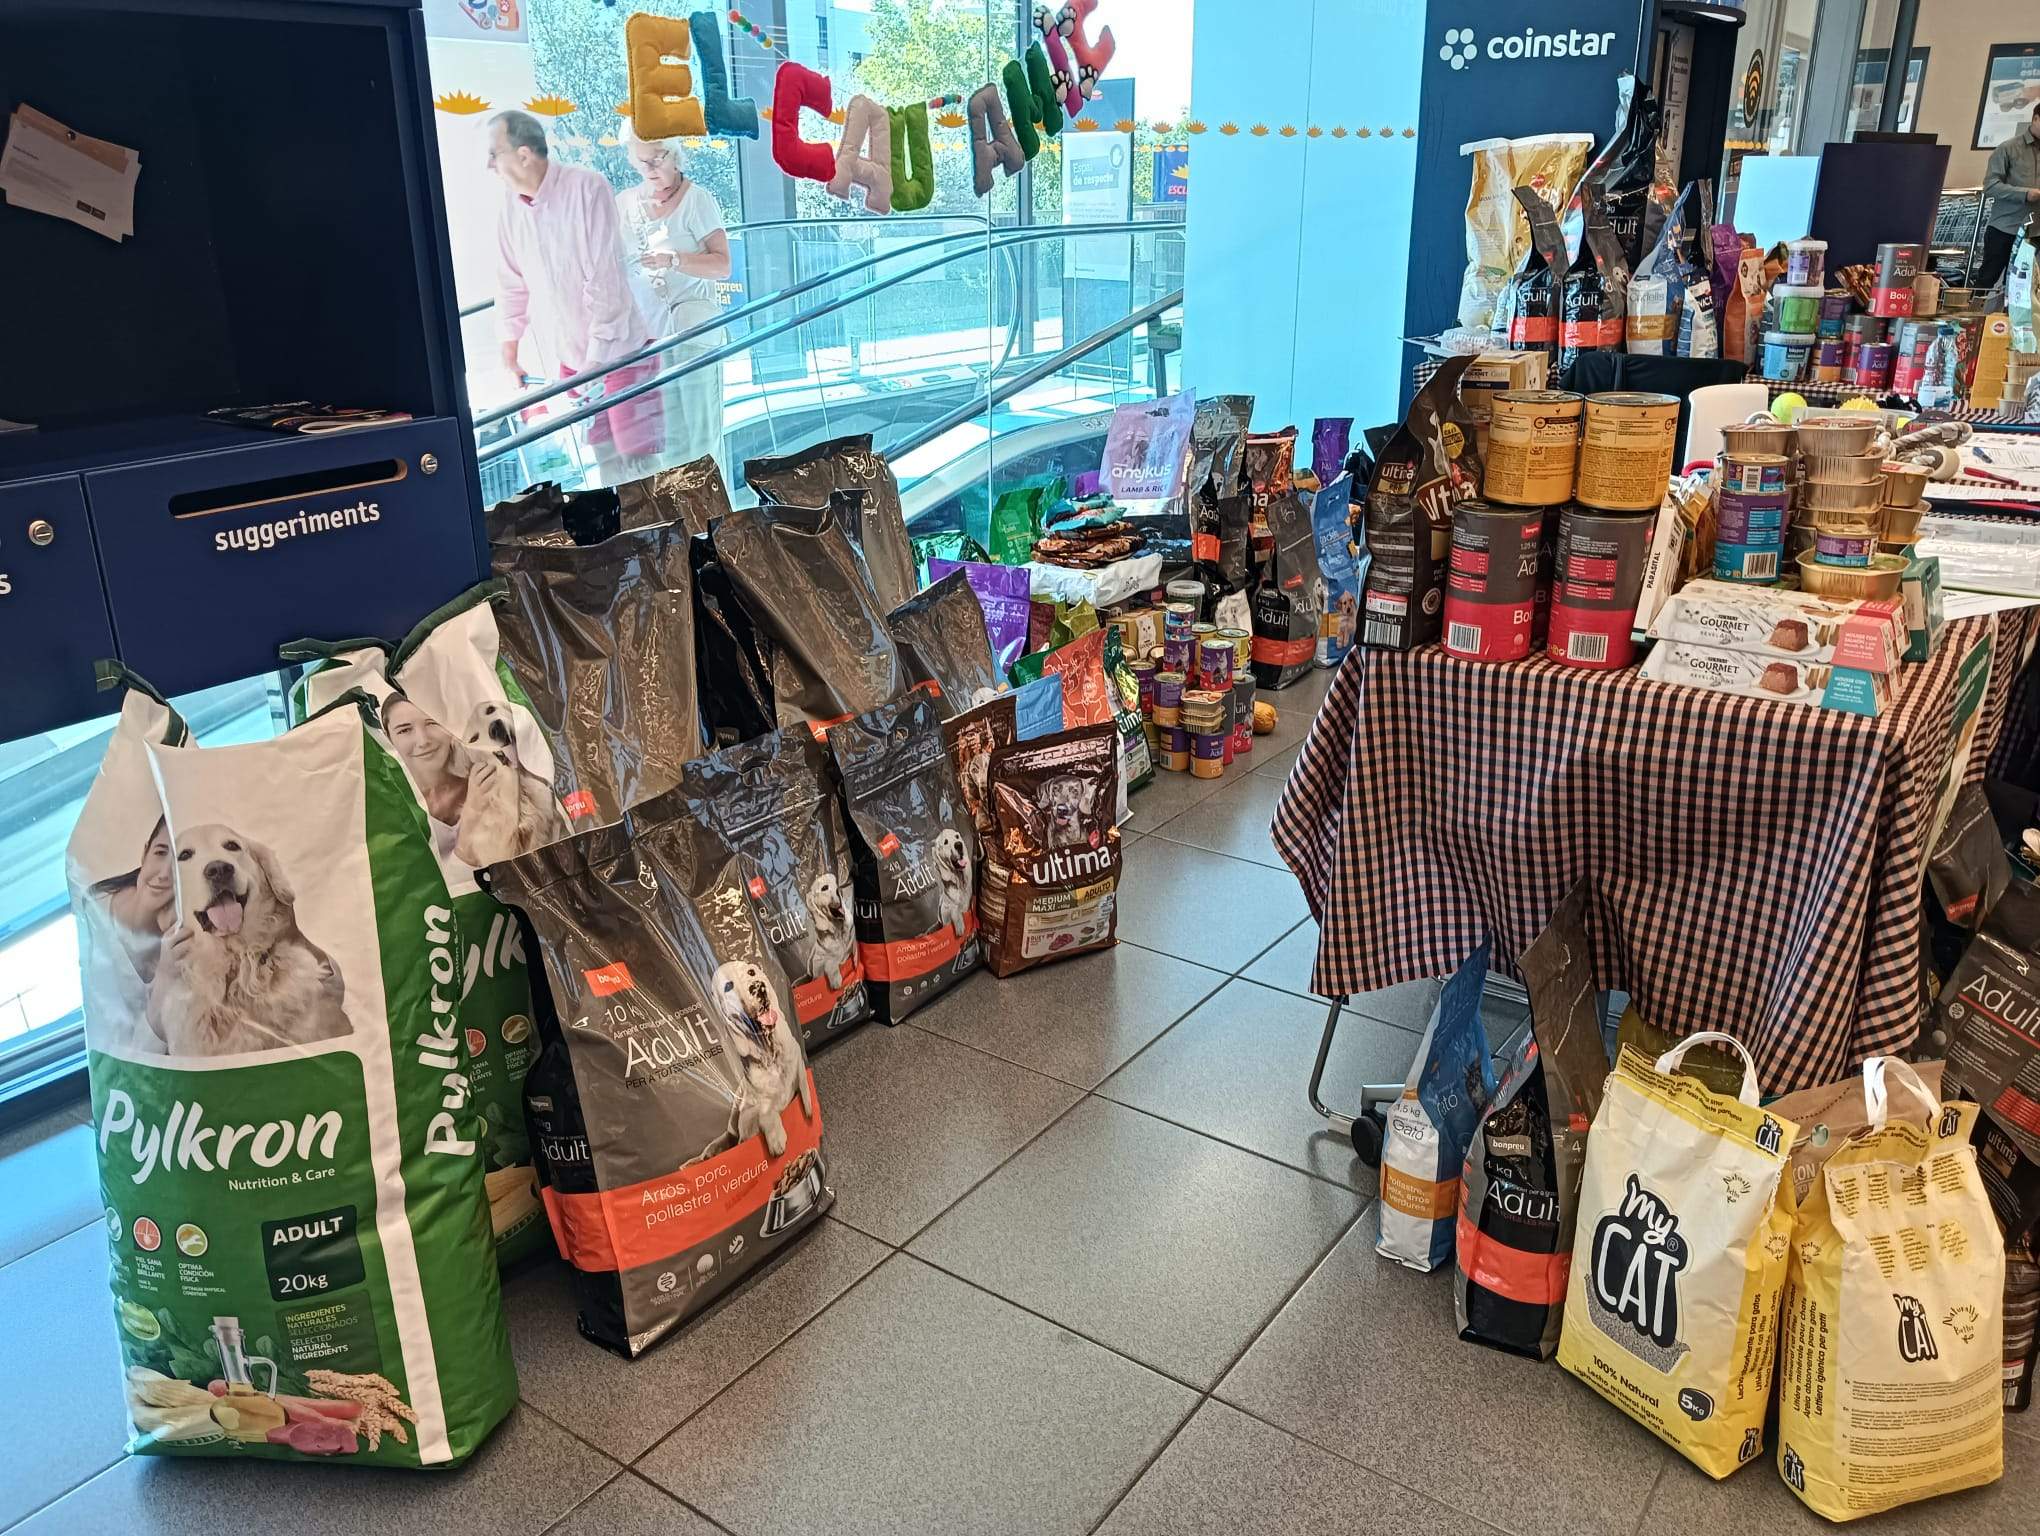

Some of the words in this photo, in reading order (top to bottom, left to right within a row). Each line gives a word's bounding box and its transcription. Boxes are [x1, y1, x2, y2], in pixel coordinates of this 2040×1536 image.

[1487, 27, 1616, 59] coinstar
[626, 12, 759, 141] EL
[772, 60, 934, 215] CAU
[1611, 220, 1637, 235] dult
[1566, 293, 1599, 306] Adult
[1111, 463, 1172, 483] amykus
[215, 501, 380, 551] suggeriments
[1646, 551, 1661, 588] PARASITAL
[1258, 608, 1289, 627] Adult
[1700, 615, 1750, 631] GOURMET
[1690, 658, 1739, 674] GOURMET
[1032, 845, 1112, 885] ultima
[894, 863, 936, 900] Adult
[1084, 881, 1111, 898] ADULTO
[1032, 904, 1056, 912] MAXI
[1033, 893, 1071, 905] MEDIUM
[770, 911, 806, 945] dult
[604, 1005, 627, 1025] 10
[416, 904, 476, 1156] Pylkron
[624, 1012, 719, 1079] Adult
[625, 1078, 647, 1090] PER
[648, 1075, 656, 1083] A
[1410, 1105, 1421, 1118] kg
[100, 1089, 343, 1185] Pylkron
[1940, 1114, 1959, 1137] CAT
[541, 1137, 590, 1162] Adult
[1492, 1139, 1525, 1151] bonpreu
[1757, 1127, 1781, 1154] CAT
[1987, 1131, 2018, 1166] ultima
[228, 1175, 288, 1192] Nutrition
[291, 1172, 302, 1184] &
[305, 1166, 336, 1182] Care
[1496, 1163, 1513, 1179] kg
[641, 1182, 691, 1207] Arròs,
[694, 1163, 732, 1190] porc,
[645, 1191, 712, 1229] pollastre
[715, 1184, 720, 1199] i
[722, 1158, 769, 1194] verdura
[1484, 1180, 1561, 1223] Adult
[1624, 1181, 1674, 1246] my
[272, 1215, 343, 1246] ADULT
[137, 1269, 166, 1280] BRILLANTE
[179, 1269, 214, 1278] CONDICIÓN
[278, 1273, 329, 1294] 20kg
[1597, 1222, 1680, 1337] CAT
[285, 1303, 346, 1323] INGREDIENTES
[1752, 1293, 1761, 1315] gatos
[1942, 1304, 1980, 1327] Naturally
[287, 1313, 337, 1330] NATURALES
[288, 1315, 359, 1337] SELECCIONADOS
[1820, 1312, 1829, 1334] gatti
[291, 1333, 332, 1347] SELECTED
[292, 1341, 331, 1354] NATURAL
[1819, 1334, 1828, 1350] per
[1902, 1313, 1937, 1359] CAT
[293, 1344, 349, 1361] INGREDIENTS
[1815, 1350, 1826, 1383] igienica
[1592, 1354, 1618, 1381] 100%
[1619, 1374, 1660, 1408] Natural
[1573, 1364, 1616, 1398] Lightweight
[1617, 1396, 1647, 1421] mineral
[1648, 1419, 1661, 1430] cat
[1662, 1427, 1682, 1445] litter
[1587, 1366, 1609, 1387] Lecho
[1610, 1384, 1640, 1408] mineral
[1641, 1405, 1665, 1425] ligero
[1814, 1384, 1824, 1416] Lettiera
[1784, 1456, 1803, 1489] CAT
